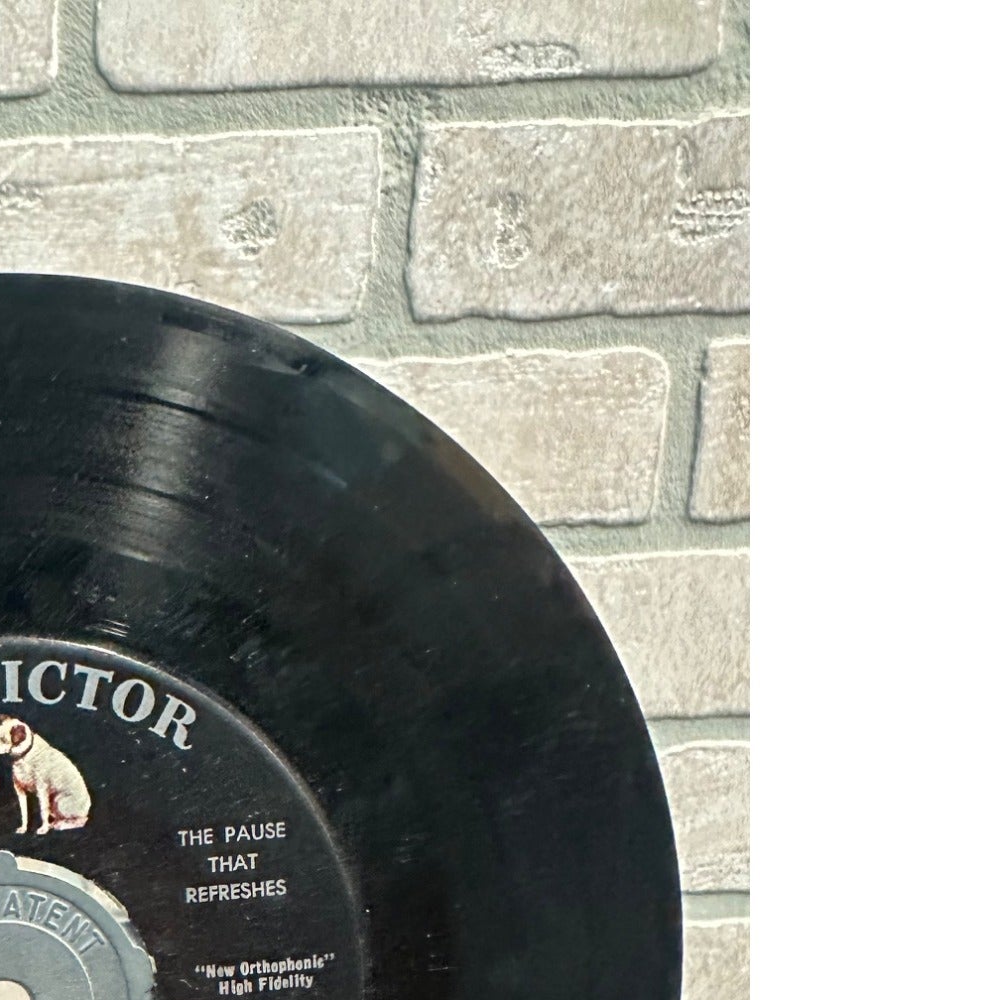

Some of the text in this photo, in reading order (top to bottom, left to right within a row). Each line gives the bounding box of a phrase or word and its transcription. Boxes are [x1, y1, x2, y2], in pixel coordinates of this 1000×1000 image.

[178, 821, 287, 847] THE PAUSE
[208, 852, 259, 873] THAT
[185, 878, 287, 904] REFRESHES
[218, 973, 314, 996] High Fidelity
